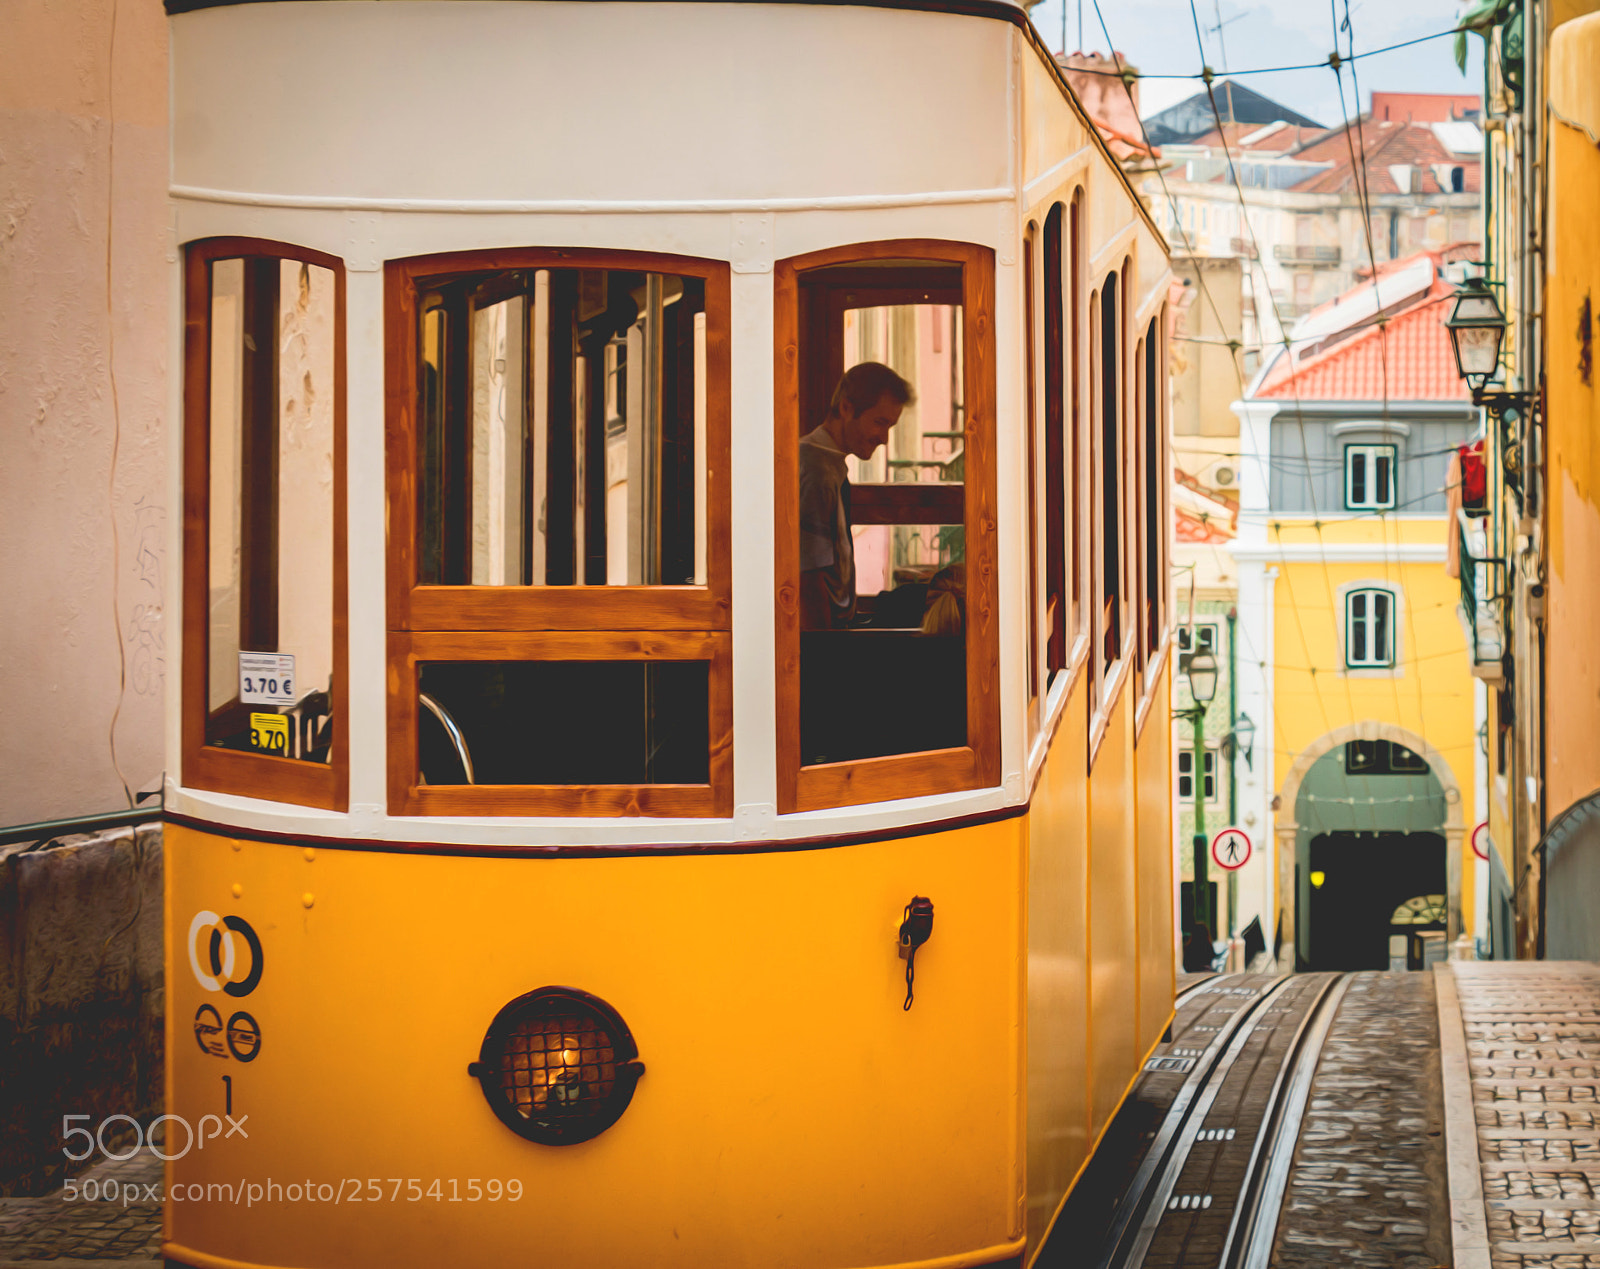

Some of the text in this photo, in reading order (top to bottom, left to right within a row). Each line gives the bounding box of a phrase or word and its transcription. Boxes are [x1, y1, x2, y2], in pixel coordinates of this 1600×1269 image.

[243, 677, 292, 695] 3.70 €
[222, 1075, 232, 1115] 1
